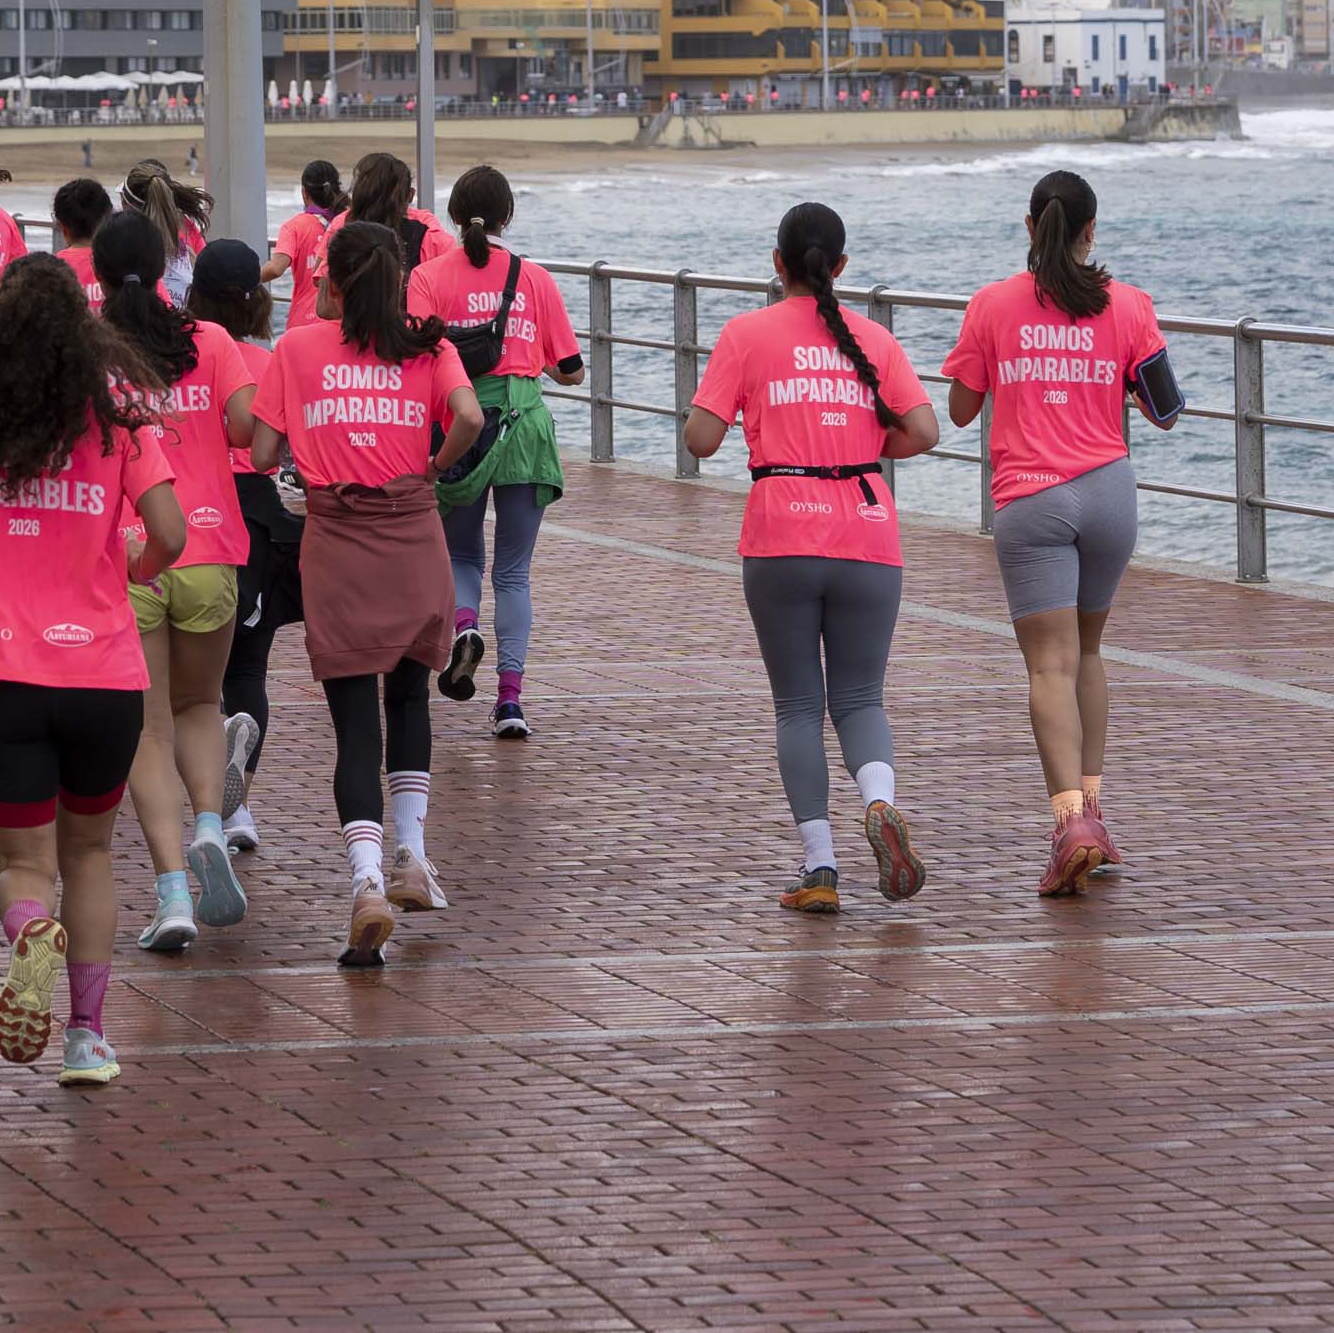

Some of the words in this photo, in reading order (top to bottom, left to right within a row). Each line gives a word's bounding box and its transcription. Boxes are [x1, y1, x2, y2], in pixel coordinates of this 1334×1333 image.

[468, 291, 525, 313] SOMS
[1020, 324, 1094, 352] SOMOS
[794, 346, 855, 372] SOMO
[322, 364, 402, 390] SOMOS
[769, 378, 875, 410] IMPARABLE
[1043, 390, 1068, 404] 2026
[821, 412, 847, 426] 2026
[349, 432, 376, 446] 2026
[1017, 473, 1059, 483] OYSHO
[790, 501, 832, 514] OYSHO
[8, 519, 40, 536] 2026
